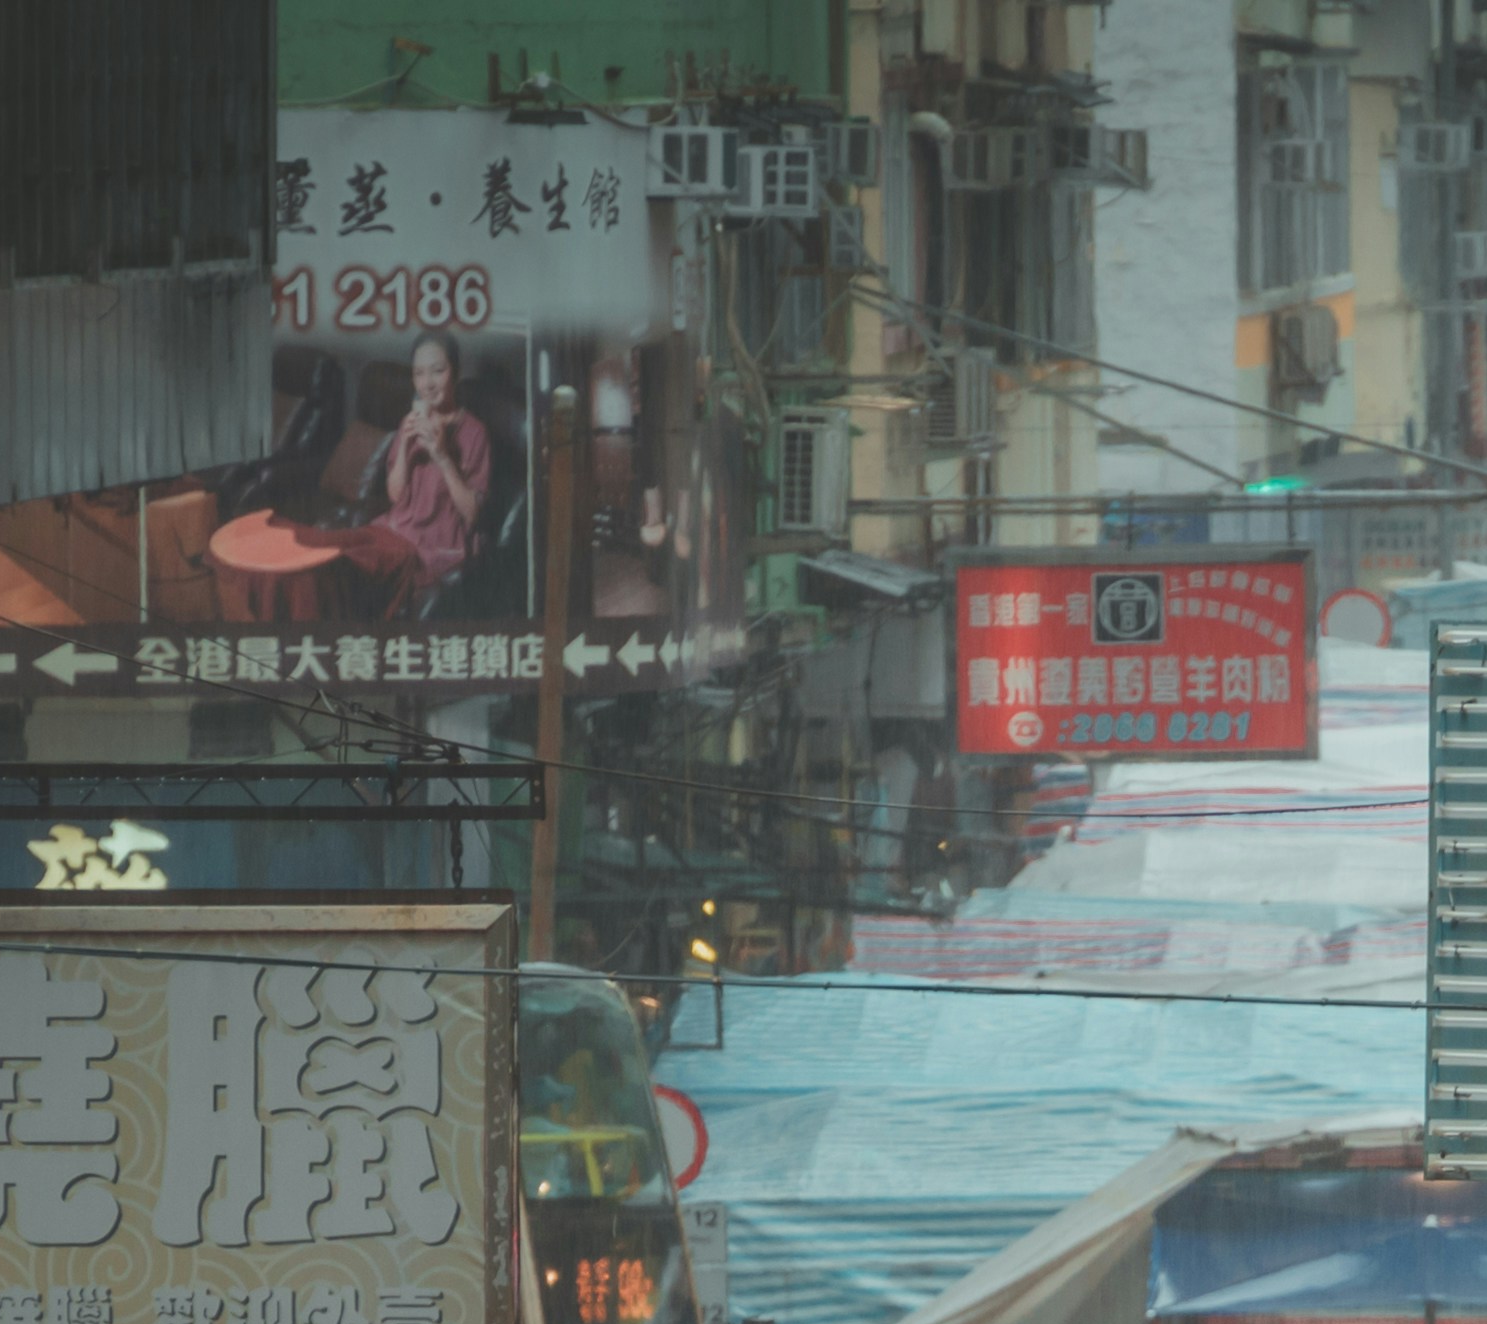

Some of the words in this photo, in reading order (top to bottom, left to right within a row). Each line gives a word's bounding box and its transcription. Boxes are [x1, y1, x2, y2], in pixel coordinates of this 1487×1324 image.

[272, 266, 316, 330] 1
[333, 263, 491, 331] 2186
[136, 635, 546, 683] 全港最大養生連鎖店
